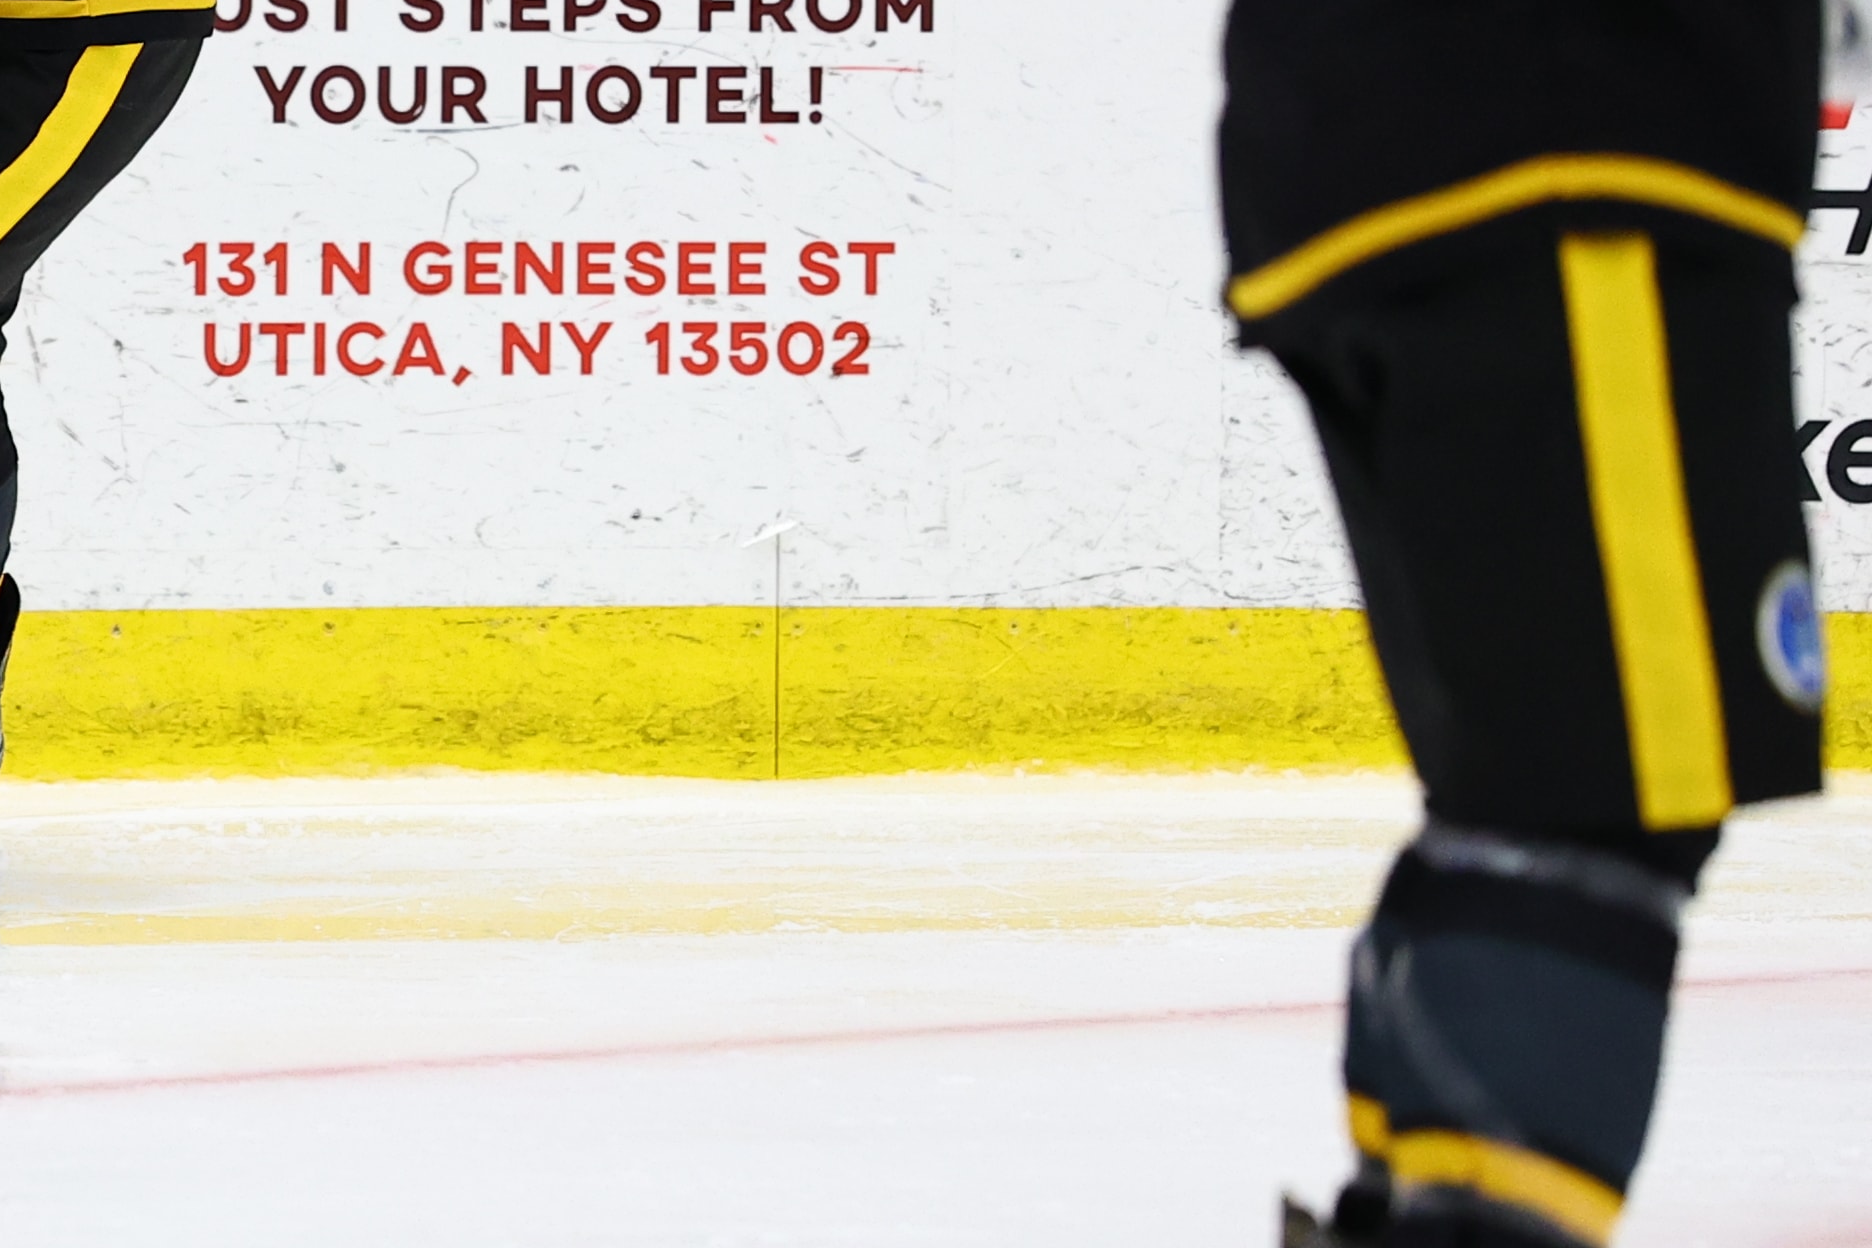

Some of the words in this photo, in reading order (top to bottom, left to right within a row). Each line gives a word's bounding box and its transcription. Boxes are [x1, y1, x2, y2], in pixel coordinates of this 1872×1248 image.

[254, 66, 488, 124] YOUR
[525, 65, 822, 124] HOTEL!
[184, 242, 288, 296] 131
[322, 243, 371, 295] N
[404, 242, 766, 296] GENESEE
[799, 242, 895, 295] ST
[204, 322, 470, 386] UTICA,
[502, 323, 612, 375] NY
[646, 322, 871, 376] 13502
